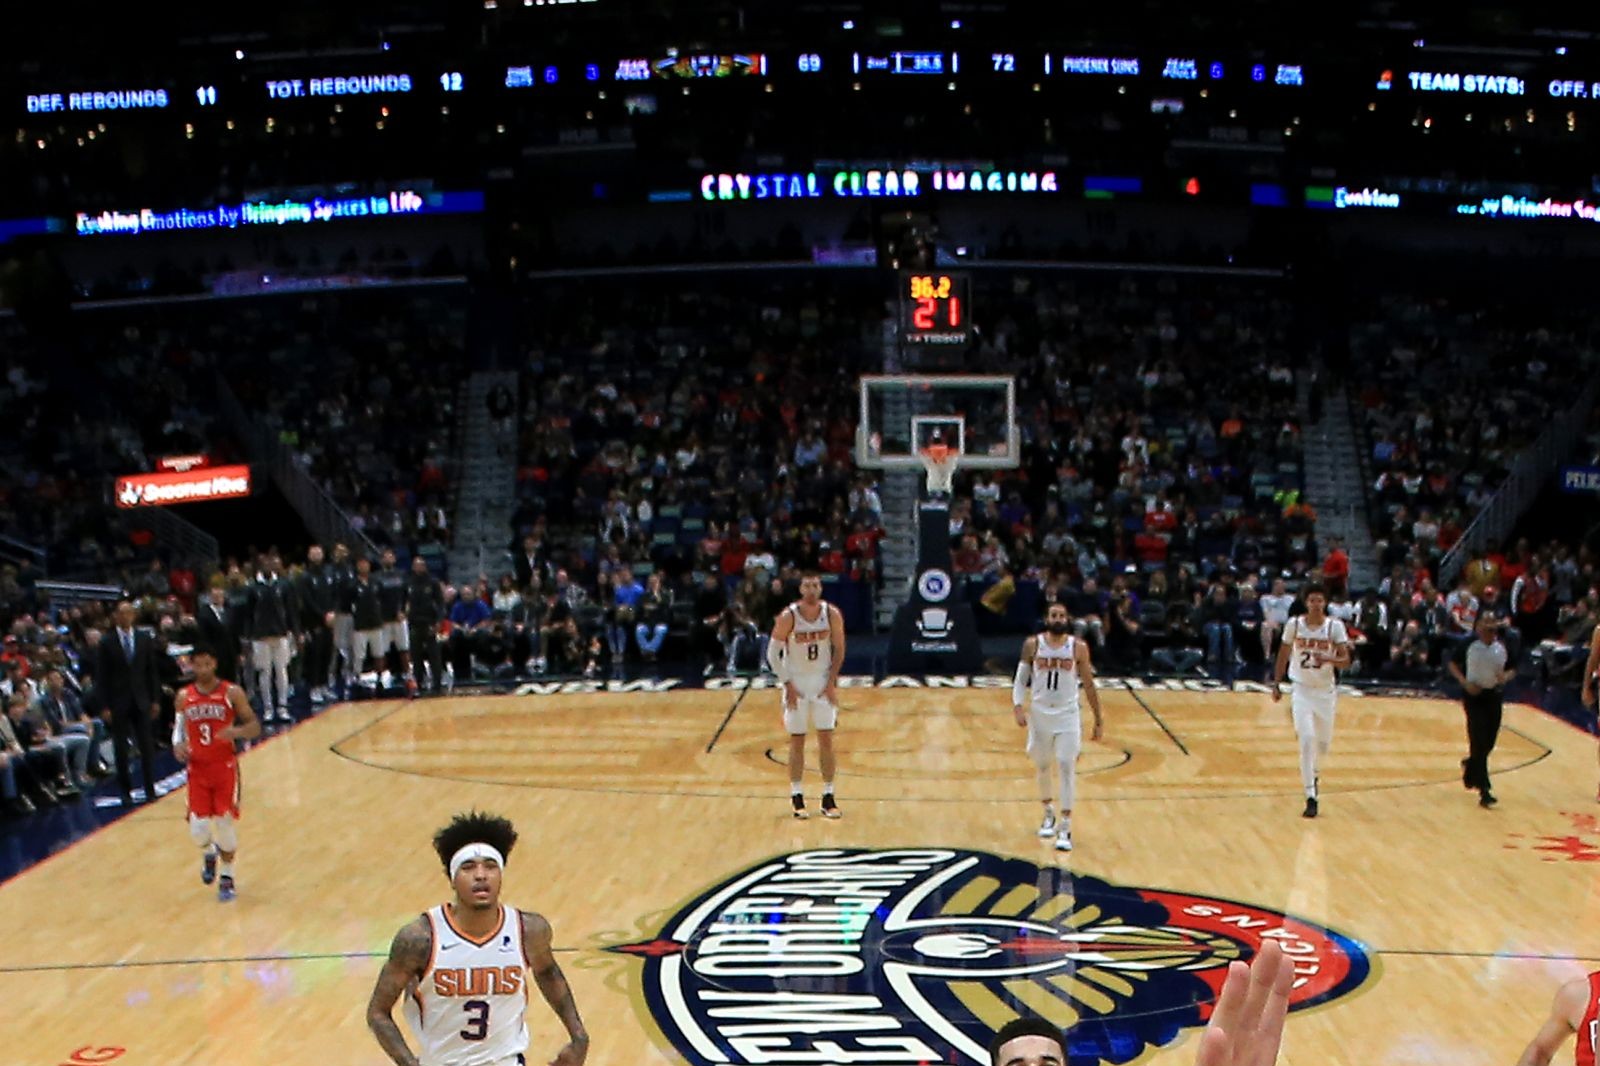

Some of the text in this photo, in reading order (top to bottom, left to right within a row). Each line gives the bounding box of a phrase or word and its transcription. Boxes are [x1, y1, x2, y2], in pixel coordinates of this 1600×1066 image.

[798, 53, 821, 72] 69
[992, 53, 1015, 72] 72
[266, 72, 463, 98] TOT. REBOUNDS 12
[1409, 71, 1459, 91] TEAM
[1549, 79, 1587, 98] OFF.
[27, 86, 216, 112] DEF. REBOUNDS 11
[701, 170, 1058, 200] CRYSTAL CLEAR IMAGING
[141, 208, 214, 230] Emotions
[911, 276, 951, 299] 36.2
[914, 297, 960, 328] 21
[1047, 670, 1059, 691] 11
[200, 722, 211, 746] 3
[693, 850, 956, 977] ORLEANS
[433, 965, 522, 997] SUNS
[460, 1000, 490, 1041] 3
